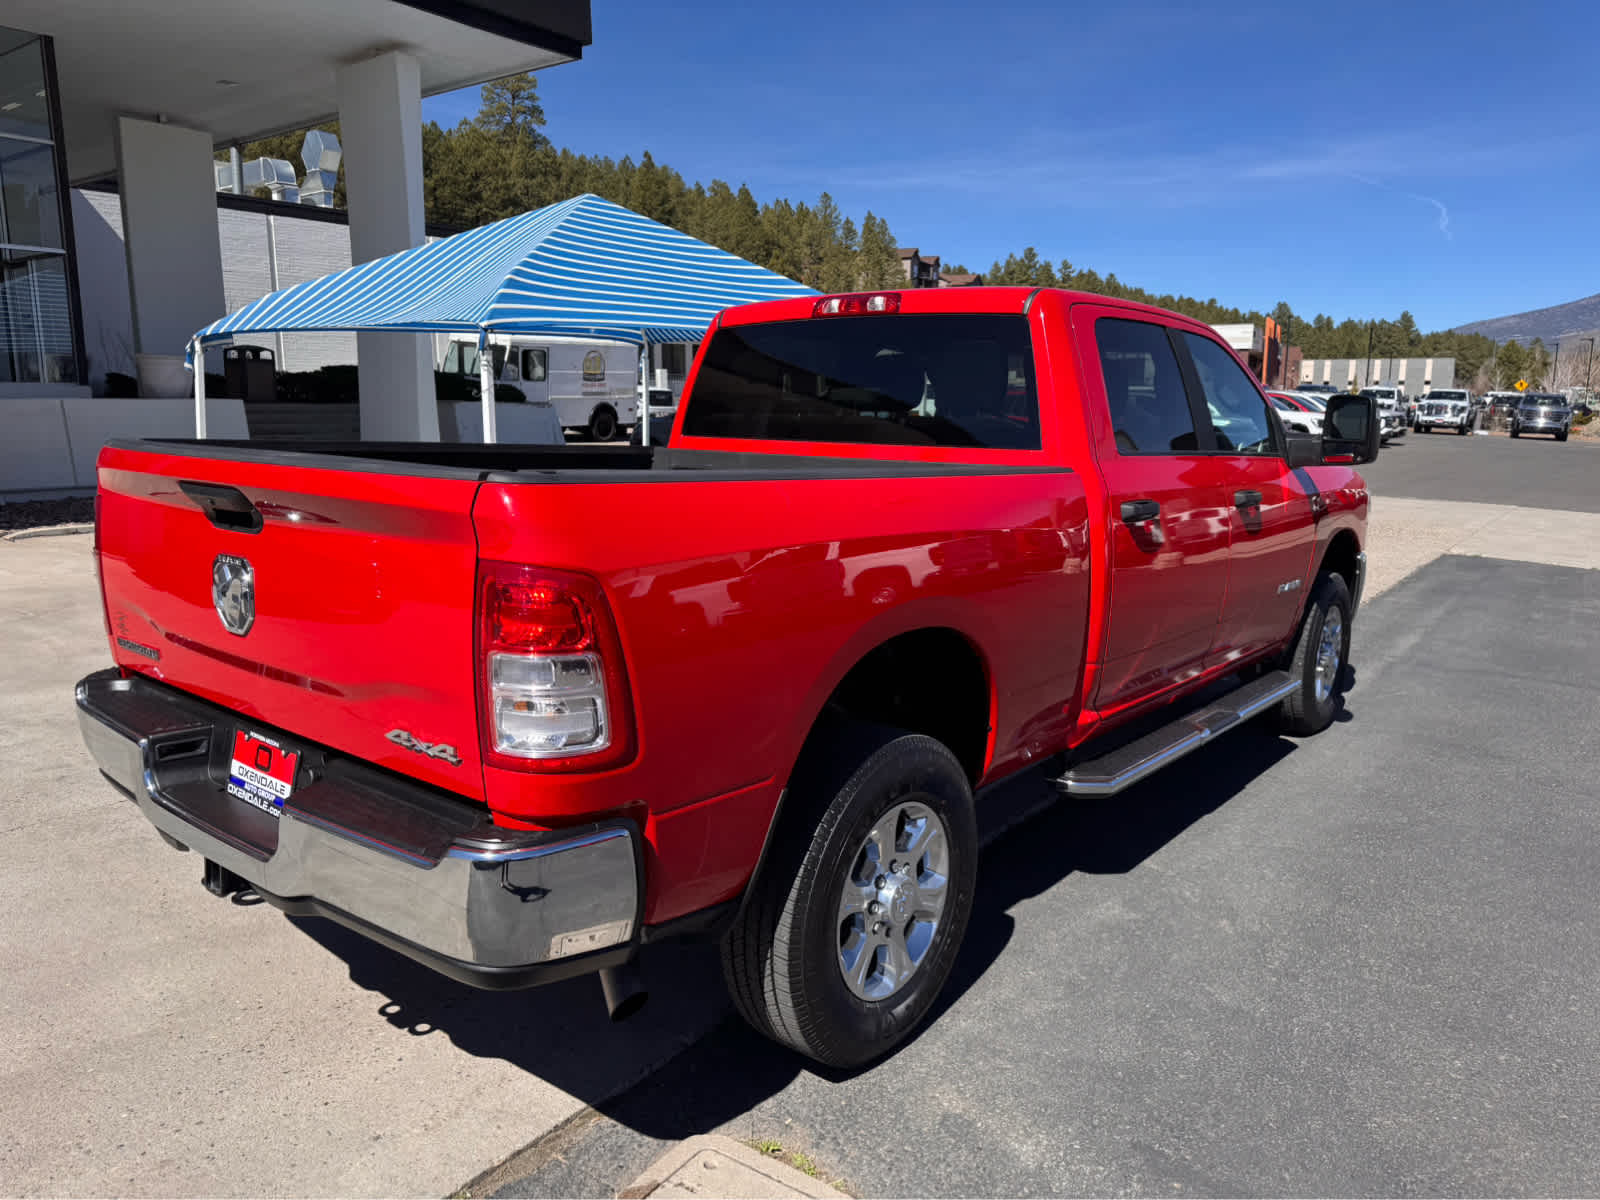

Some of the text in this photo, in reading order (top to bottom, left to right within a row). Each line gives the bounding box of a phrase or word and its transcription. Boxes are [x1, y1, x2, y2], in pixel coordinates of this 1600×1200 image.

[238, 766, 286, 796] OXENDALE
[244, 782, 276, 801] AUTO GROUP
